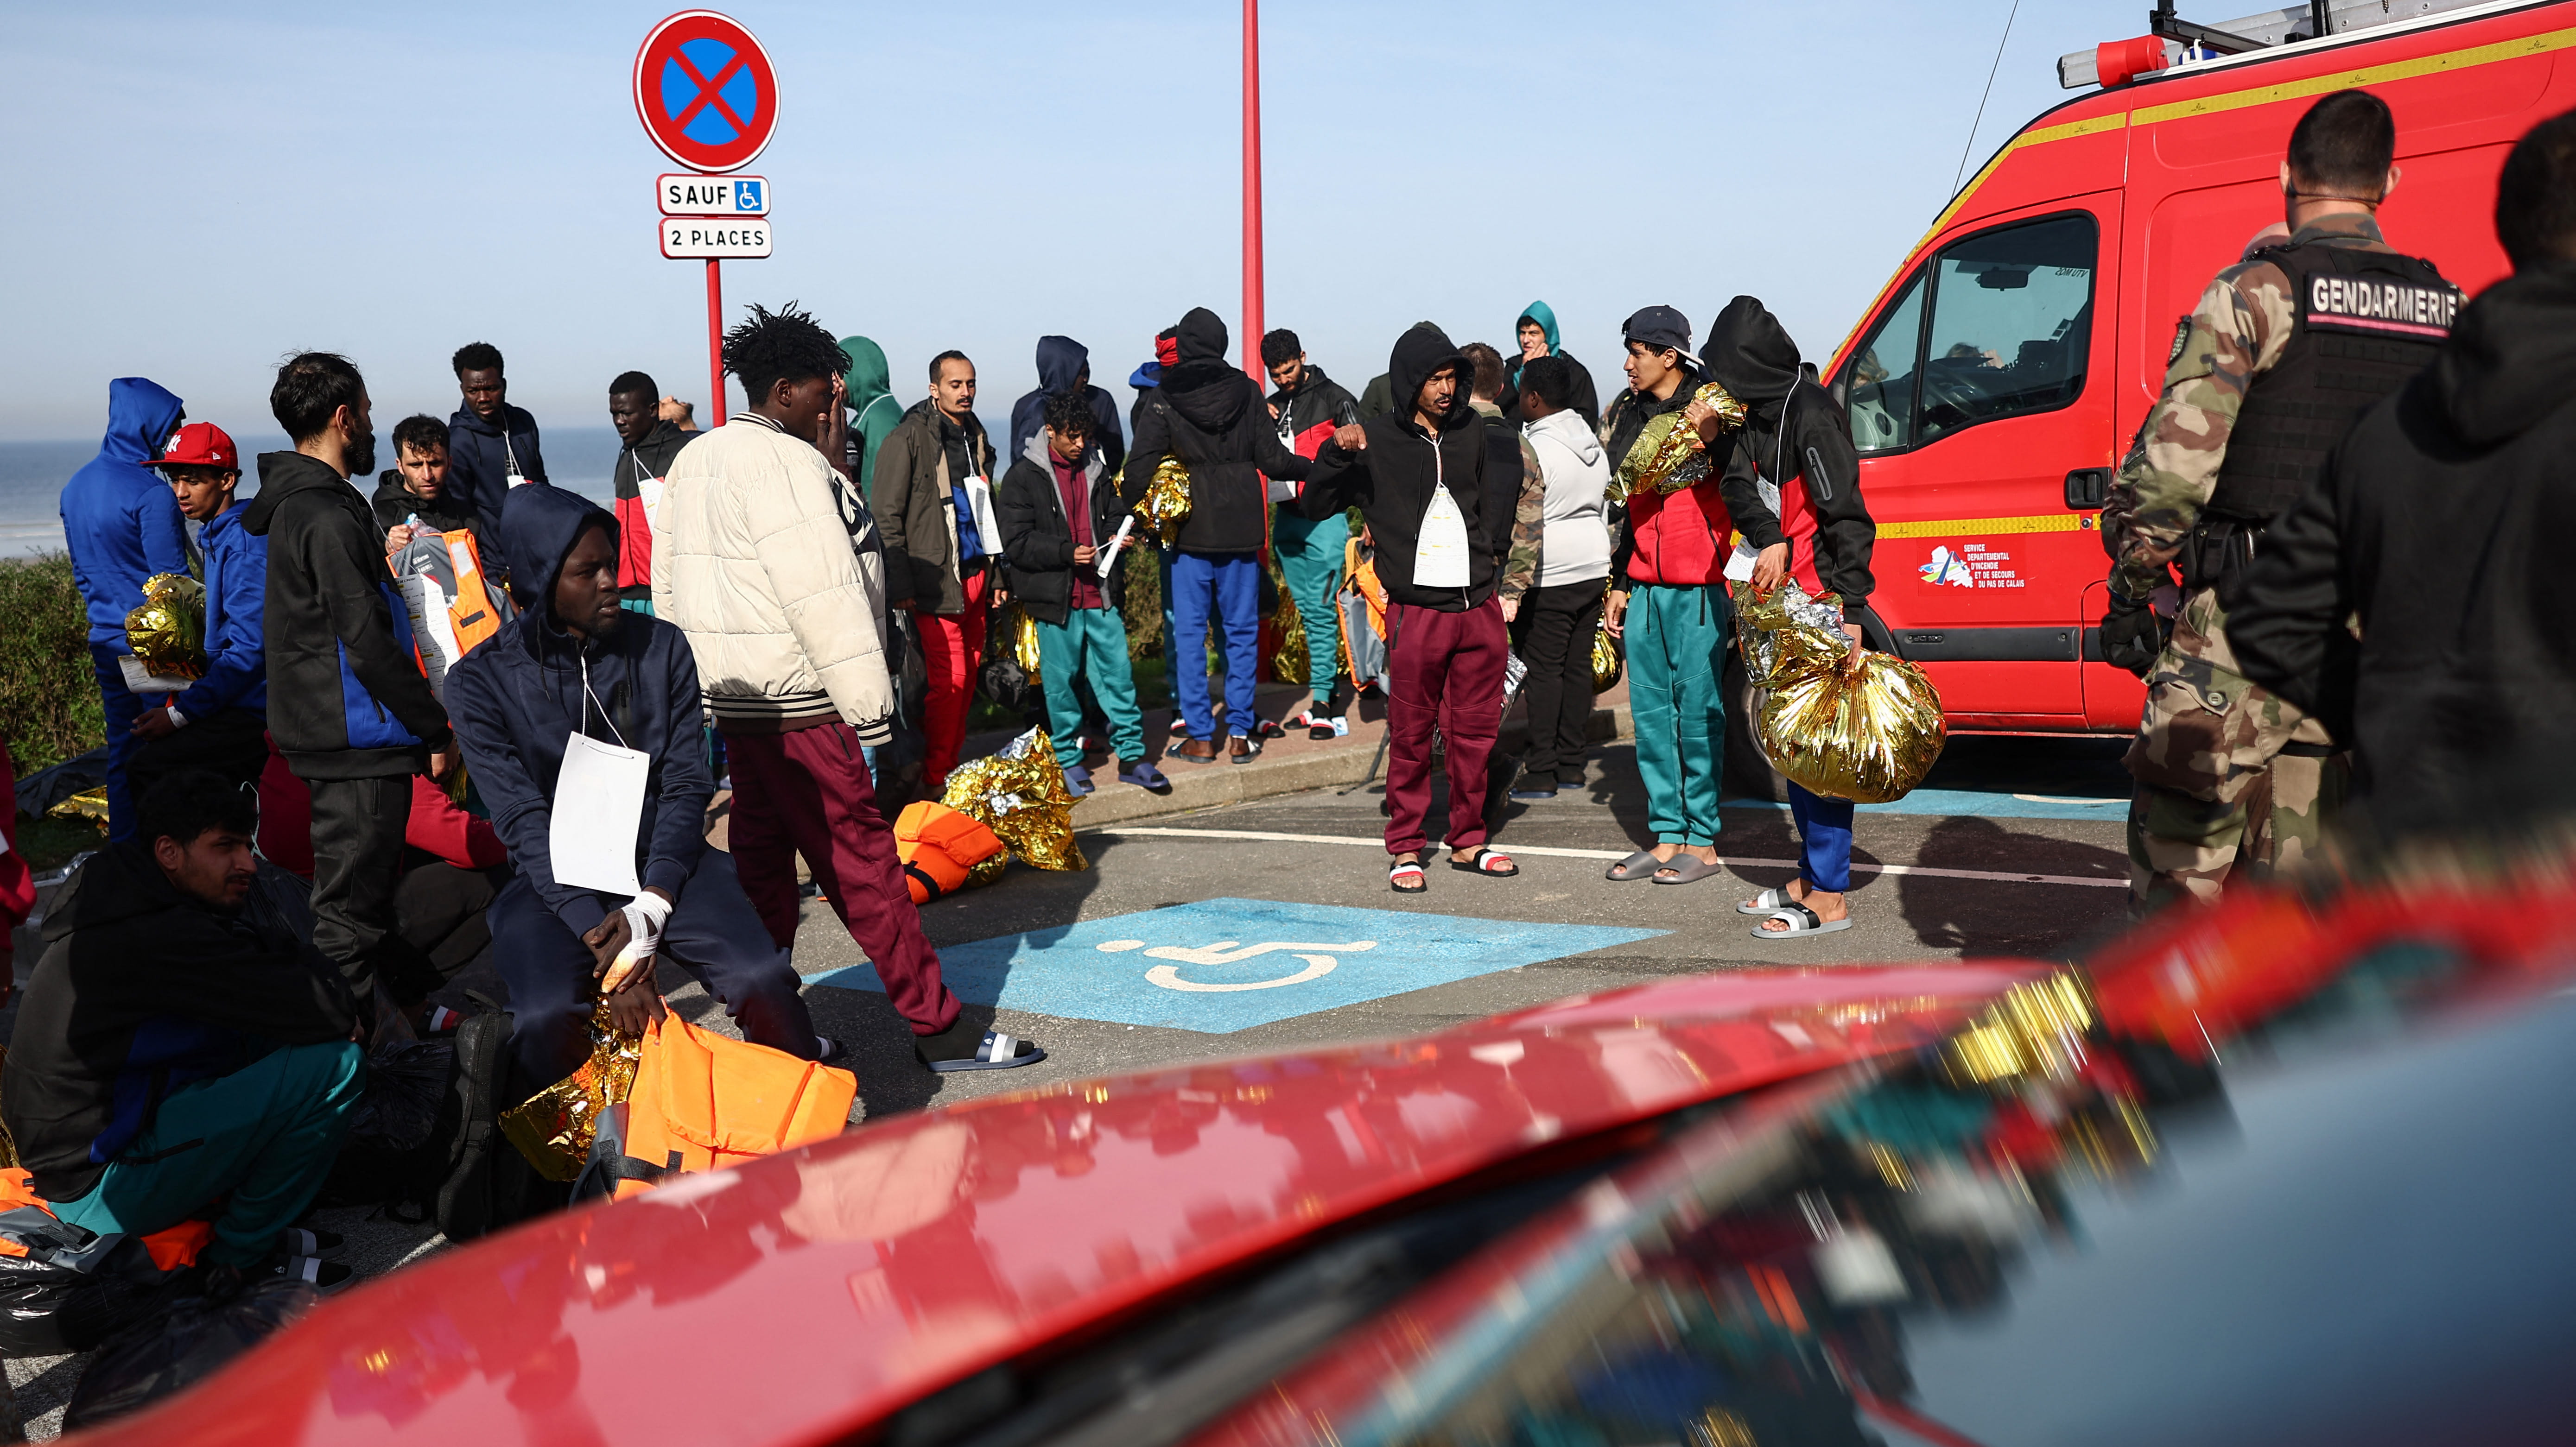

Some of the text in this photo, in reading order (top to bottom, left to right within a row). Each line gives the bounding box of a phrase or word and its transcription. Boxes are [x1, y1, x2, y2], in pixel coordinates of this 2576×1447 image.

[669, 185, 727, 204] SAUF
[672, 230, 764, 246] 2 PLACES
[2312, 278, 2456, 328] GENDARMERIE
[1964, 543, 1985, 552] SERVICE
[1967, 552, 2010, 561] DEPARTEMENTAL
[1971, 562, 1999, 570] D'INCENDIE
[1991, 570, 2015, 579] SECOURS
